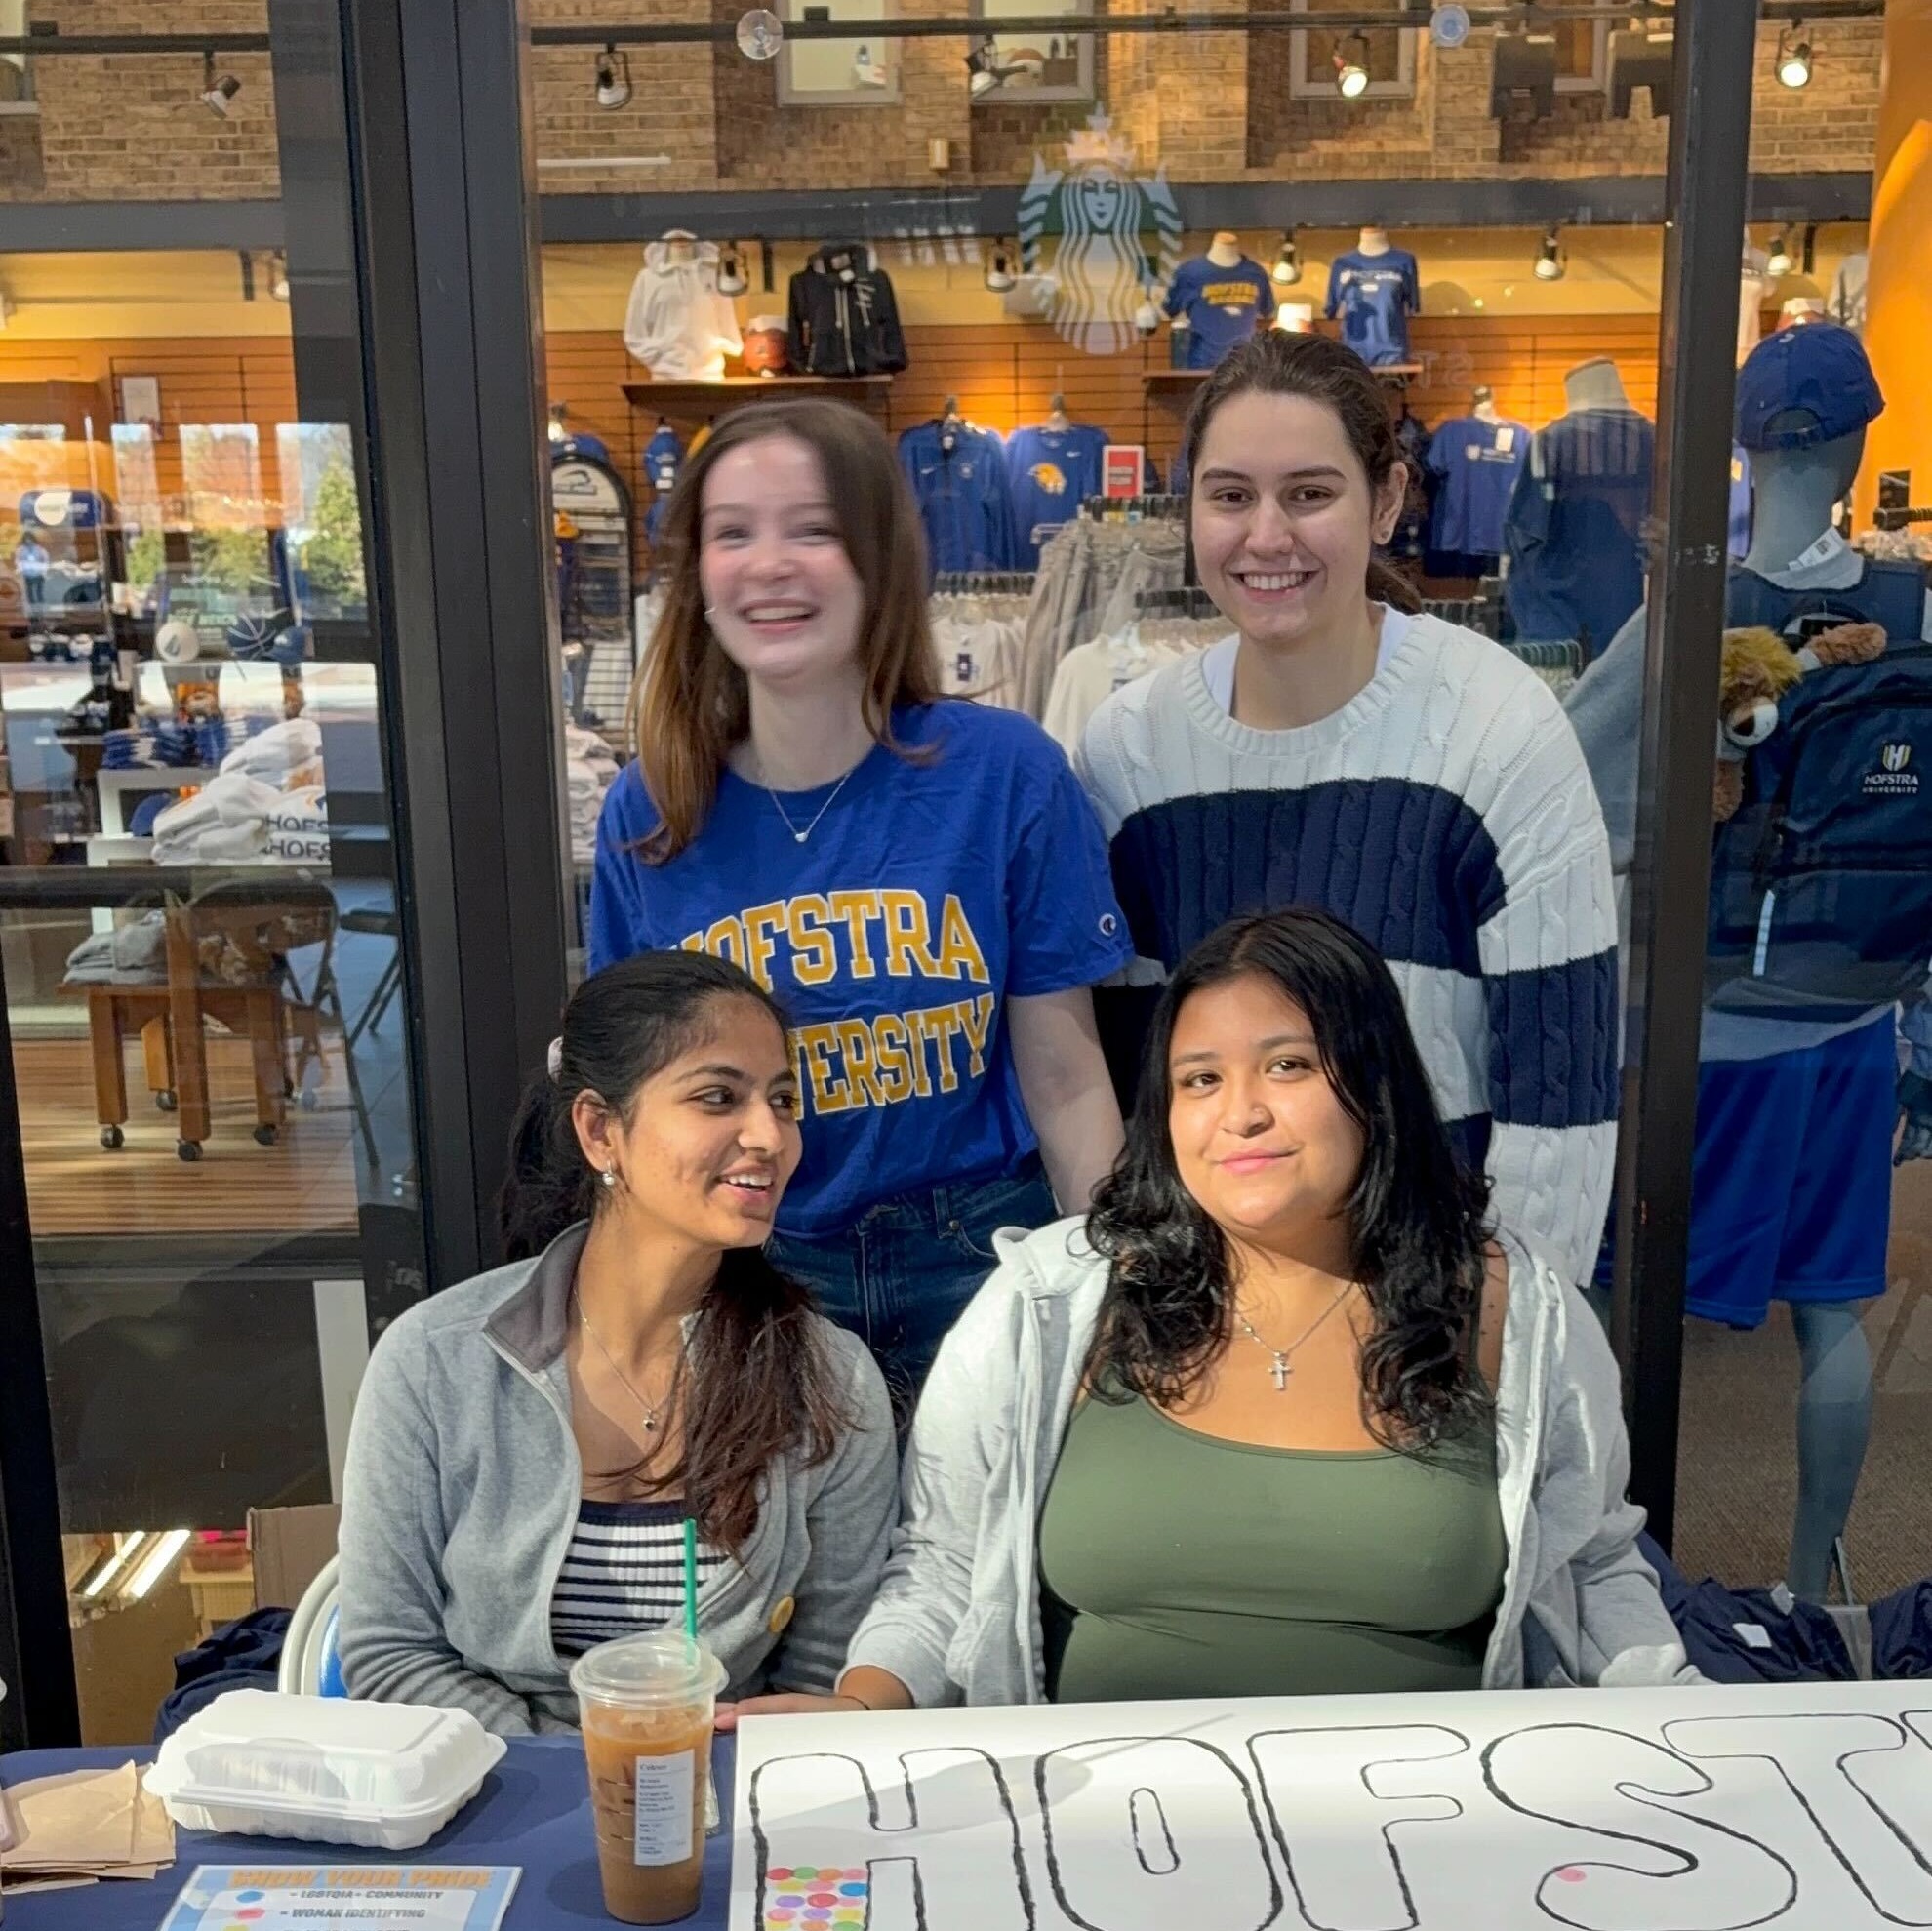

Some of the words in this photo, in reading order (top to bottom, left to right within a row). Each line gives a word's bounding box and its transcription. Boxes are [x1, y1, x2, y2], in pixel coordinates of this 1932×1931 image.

[669, 889, 990, 994] OFSTRA
[750, 1709, 1932, 1931] HOFST
[408, 1869, 494, 1889] PRIDE
[365, 1890, 444, 1900] COMMUNITY
[292, 1909, 342, 1918] WOMAN
[344, 1909, 426, 1918] IDENTIFYING
